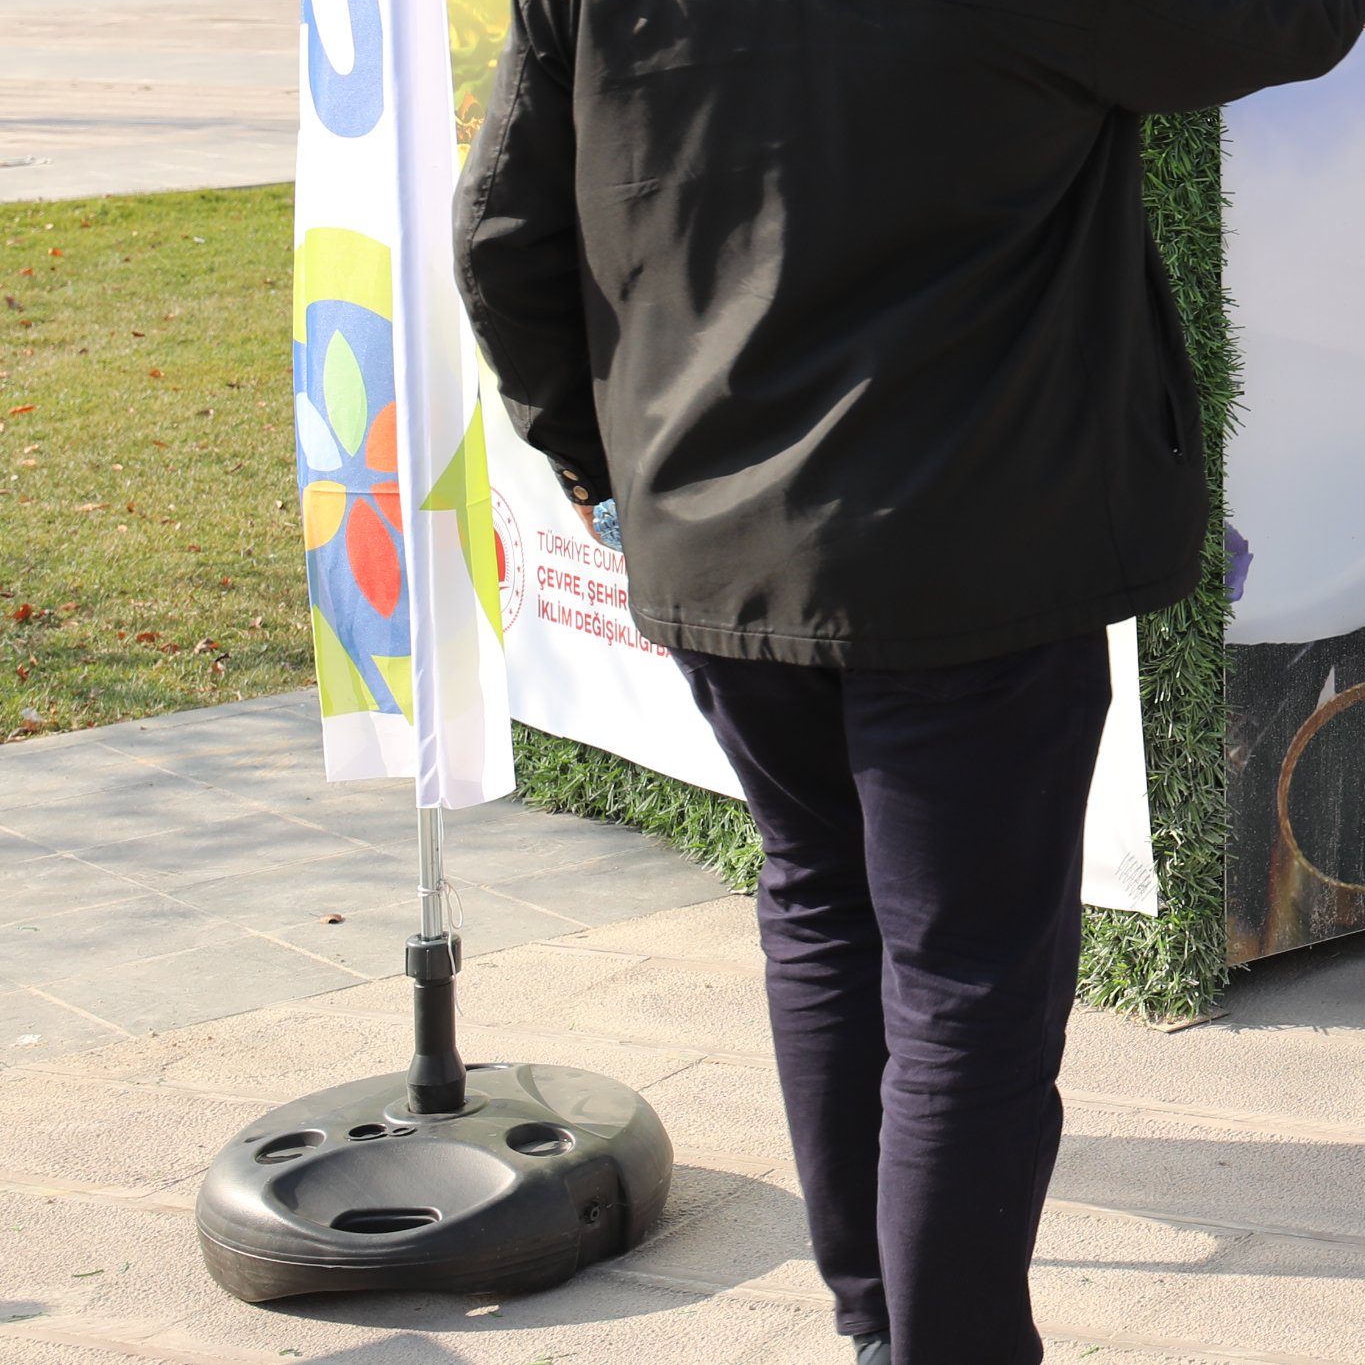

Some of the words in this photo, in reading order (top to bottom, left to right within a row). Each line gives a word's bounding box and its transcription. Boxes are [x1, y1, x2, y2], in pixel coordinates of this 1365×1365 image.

[536, 529, 590, 565] TÜRKİYE
[593, 547, 628, 576] CUM
[536, 565, 585, 601] ÇEVRE,
[537, 593, 573, 627] İKLİM
